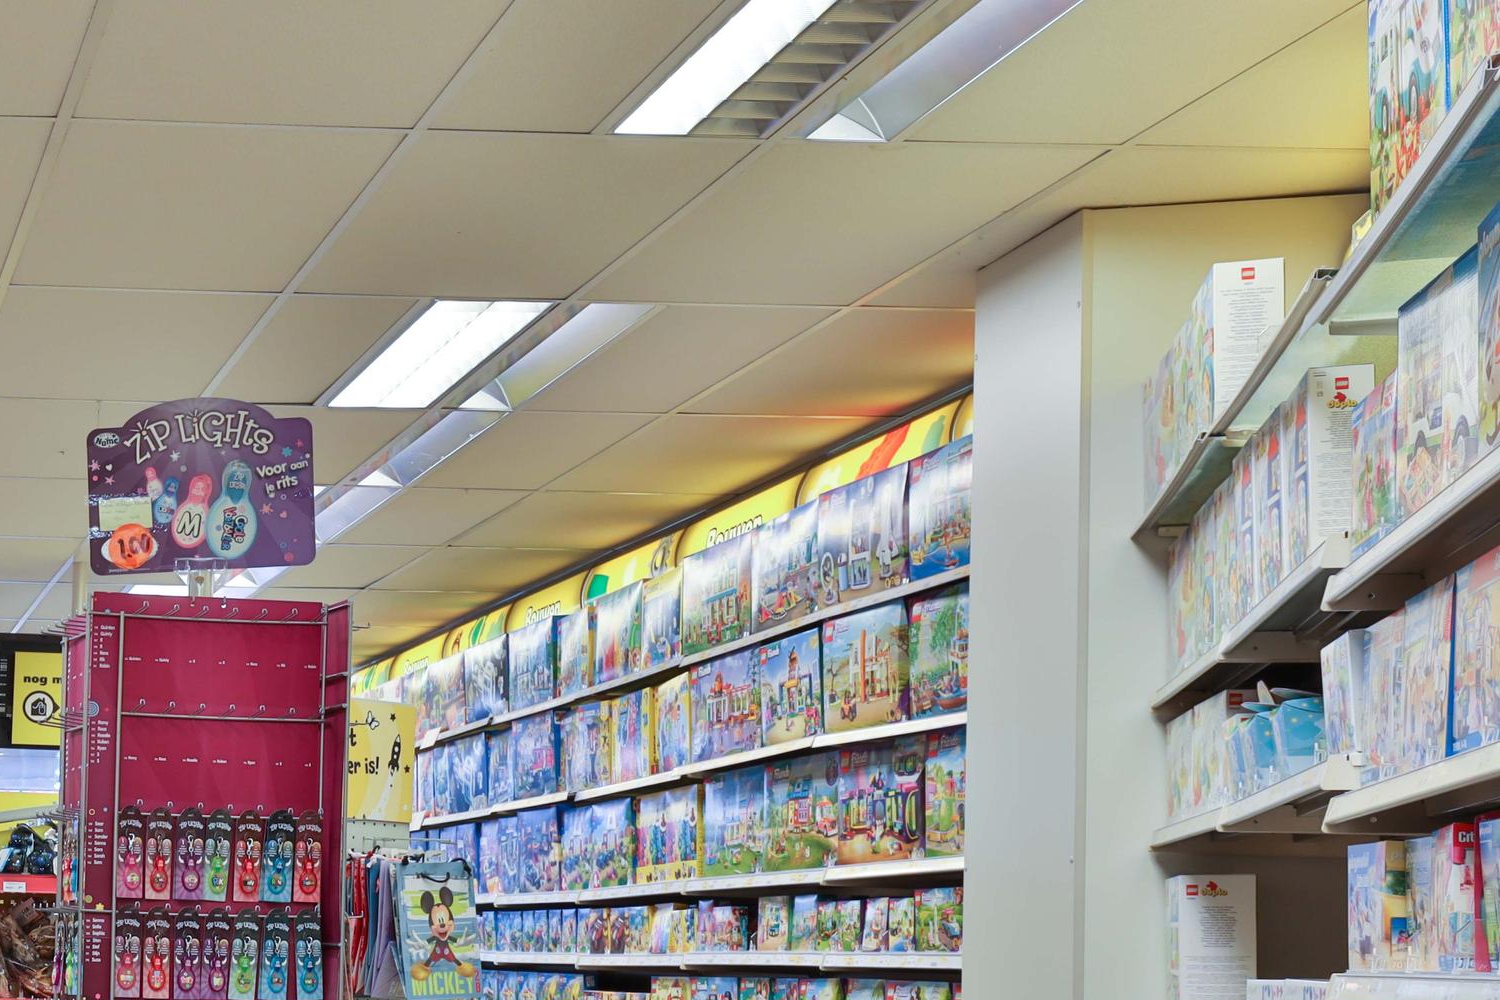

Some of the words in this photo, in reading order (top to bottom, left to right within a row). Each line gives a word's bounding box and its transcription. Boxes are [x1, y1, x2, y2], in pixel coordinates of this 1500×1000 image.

[256, 462, 288, 478] Voor
[290, 459, 308, 470] aan
[276, 476, 298, 488] rits
[23, 676, 48, 686] nog
[411, 971, 474, 997] MICKEY
